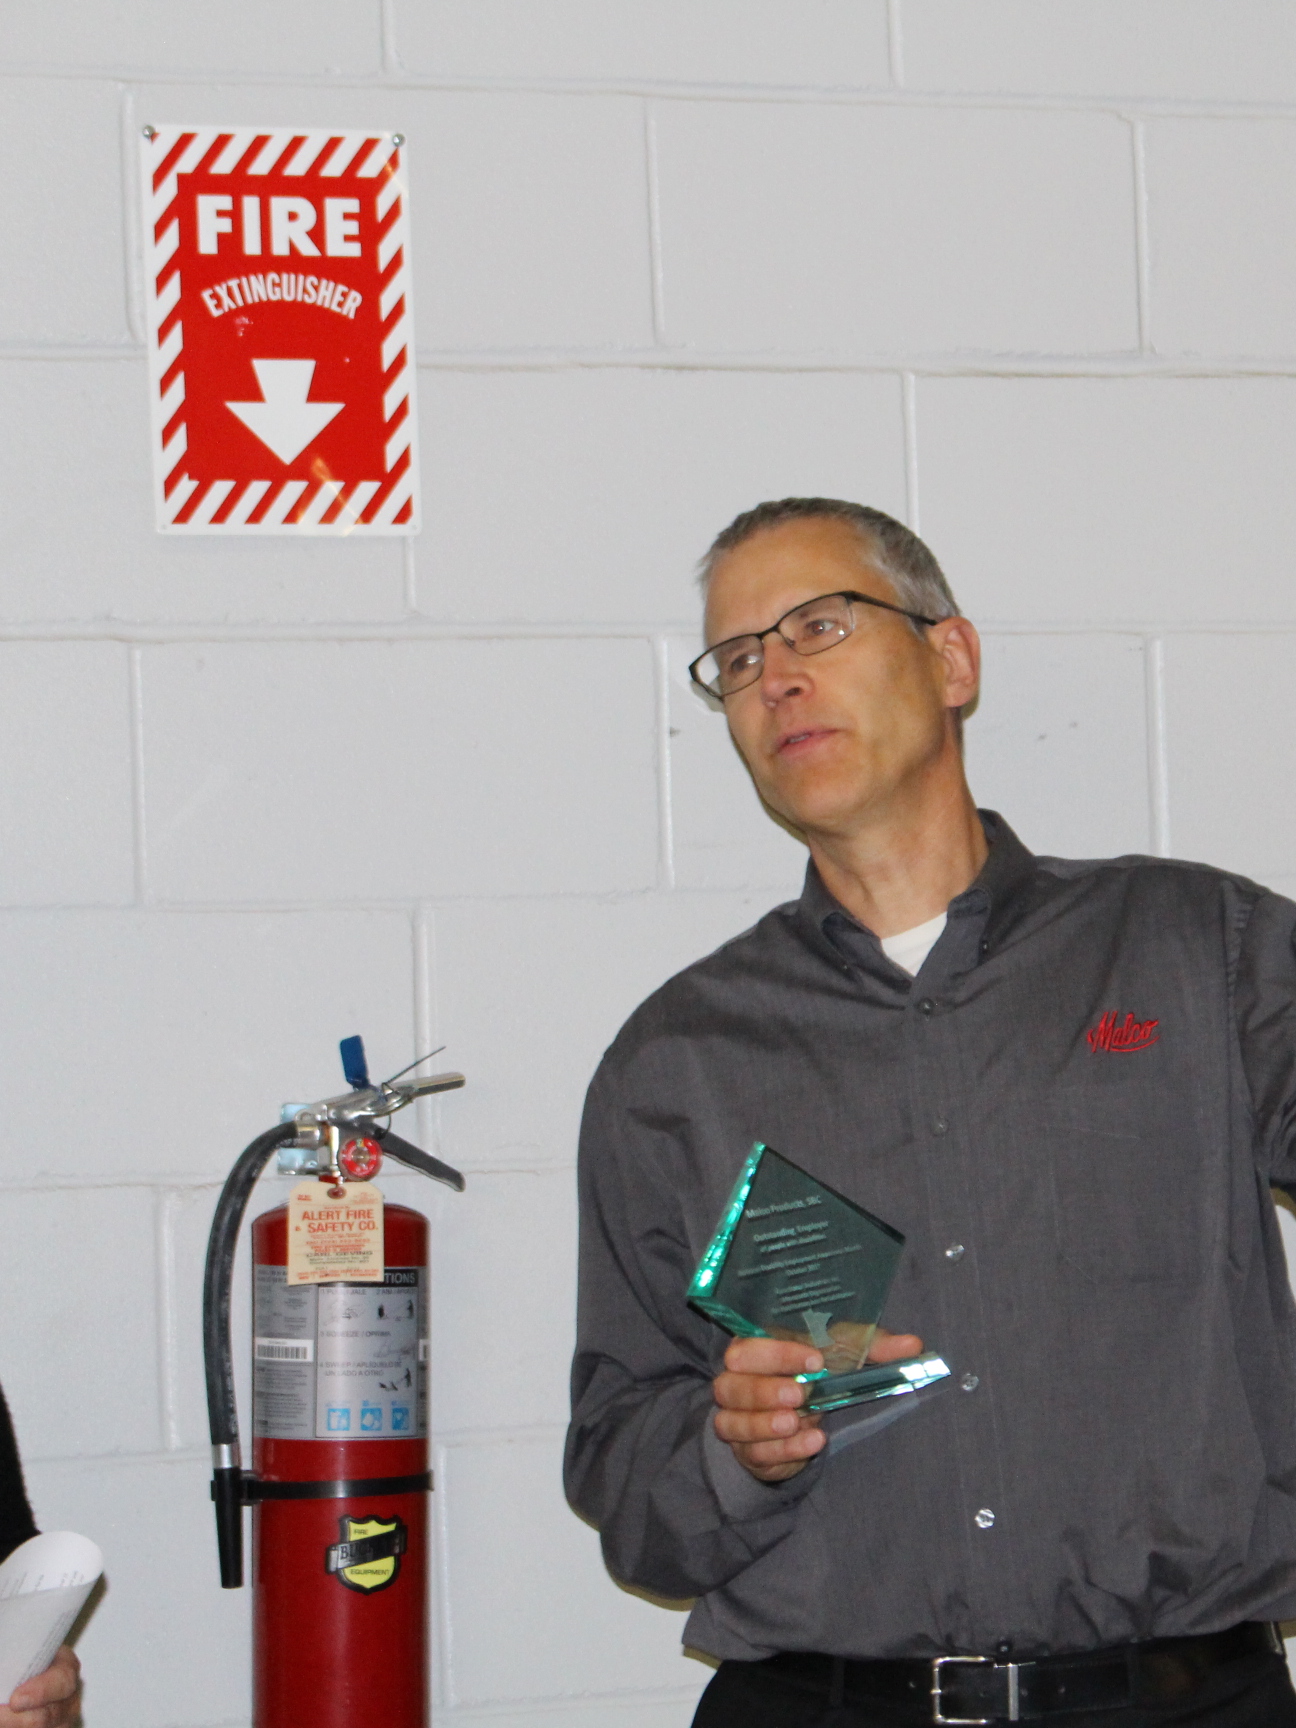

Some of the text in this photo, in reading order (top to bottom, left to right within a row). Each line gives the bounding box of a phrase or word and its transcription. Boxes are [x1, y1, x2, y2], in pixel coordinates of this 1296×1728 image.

[195, 194, 362, 258] FIRE
[201, 271, 364, 320] EXTINGUISHER
[302, 1208, 374, 1222] ALERT FIRE
[308, 1221, 355, 1234] SAFETY
[358, 1220, 379, 1231] CO.
[753, 1228, 795, 1242] Outstanding
[384, 1272, 416, 1284] TIONS
[350, 1568, 390, 1576] EQUIPMENT
